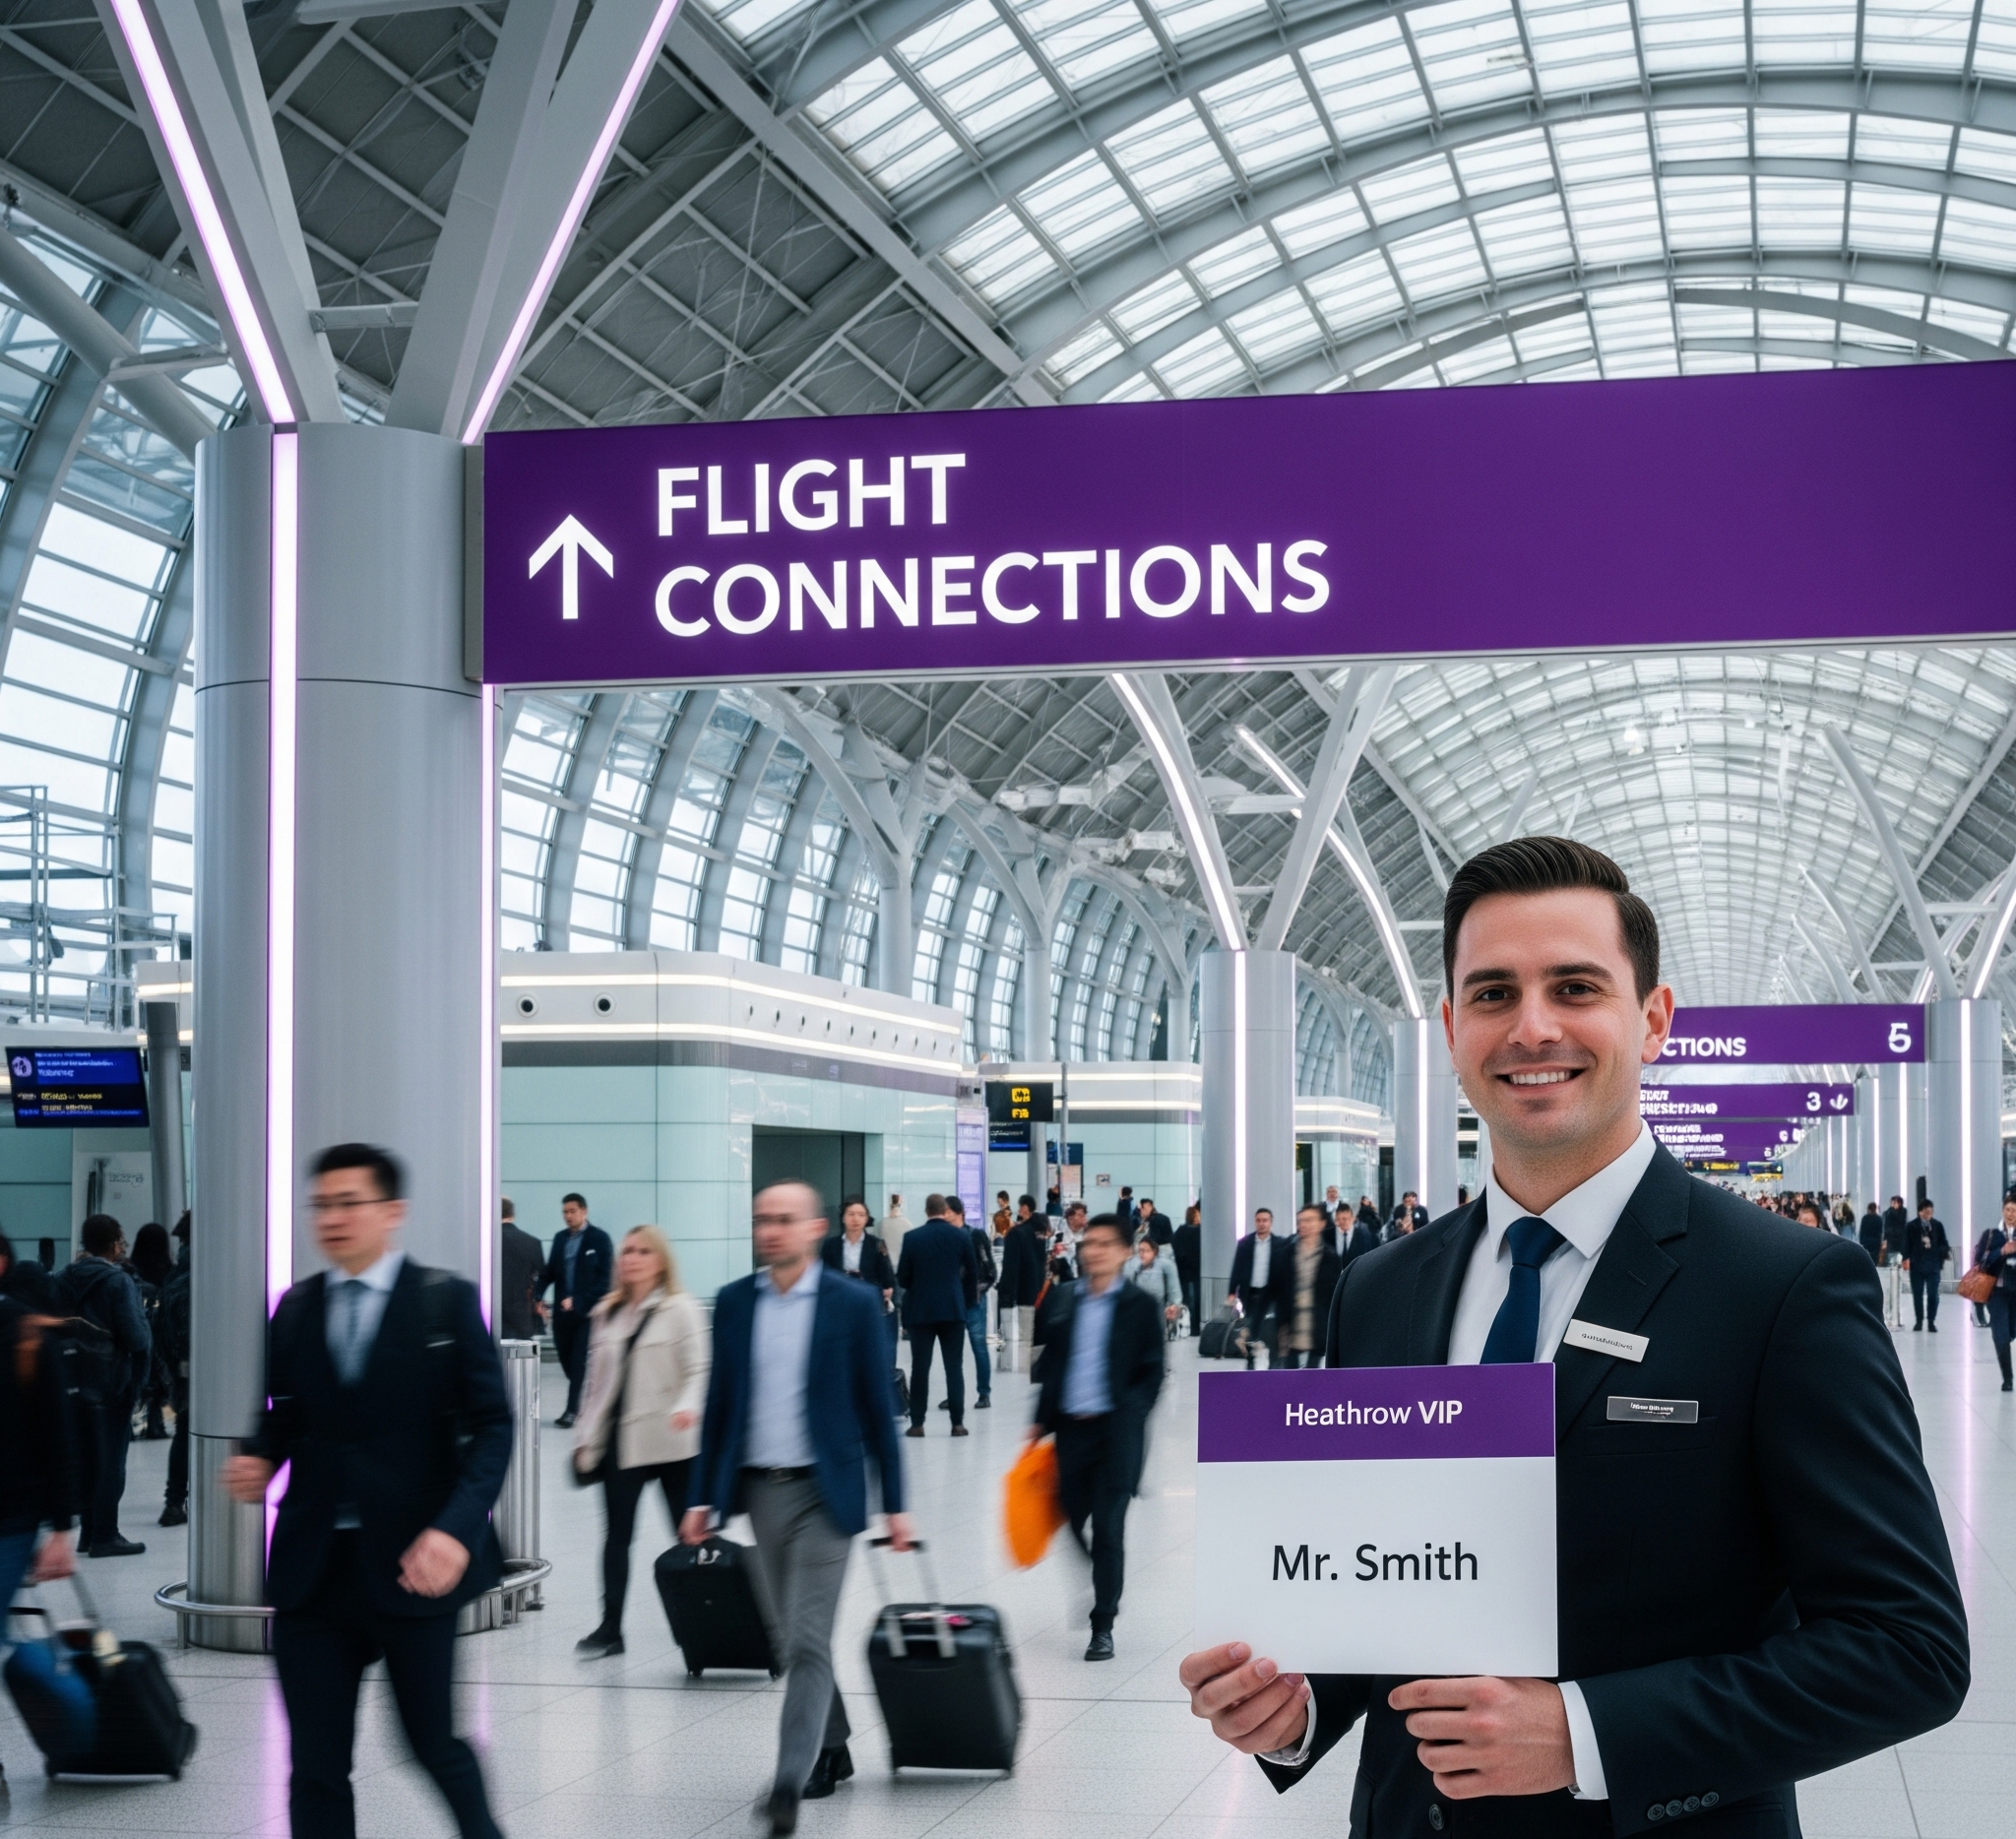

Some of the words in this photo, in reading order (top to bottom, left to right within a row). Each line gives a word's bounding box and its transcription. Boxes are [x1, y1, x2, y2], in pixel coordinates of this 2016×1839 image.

[658, 453, 967, 537] FLIGHT
[655, 539, 1330, 638] CONNECTIONS
[1805, 1091, 1822, 1112] 3
[1286, 1399, 1413, 1427] Heathrow
[1416, 1399, 1464, 1426] VIP
[1271, 1543, 1340, 1582] Mr.
[1354, 1540, 1480, 1583] Smith
